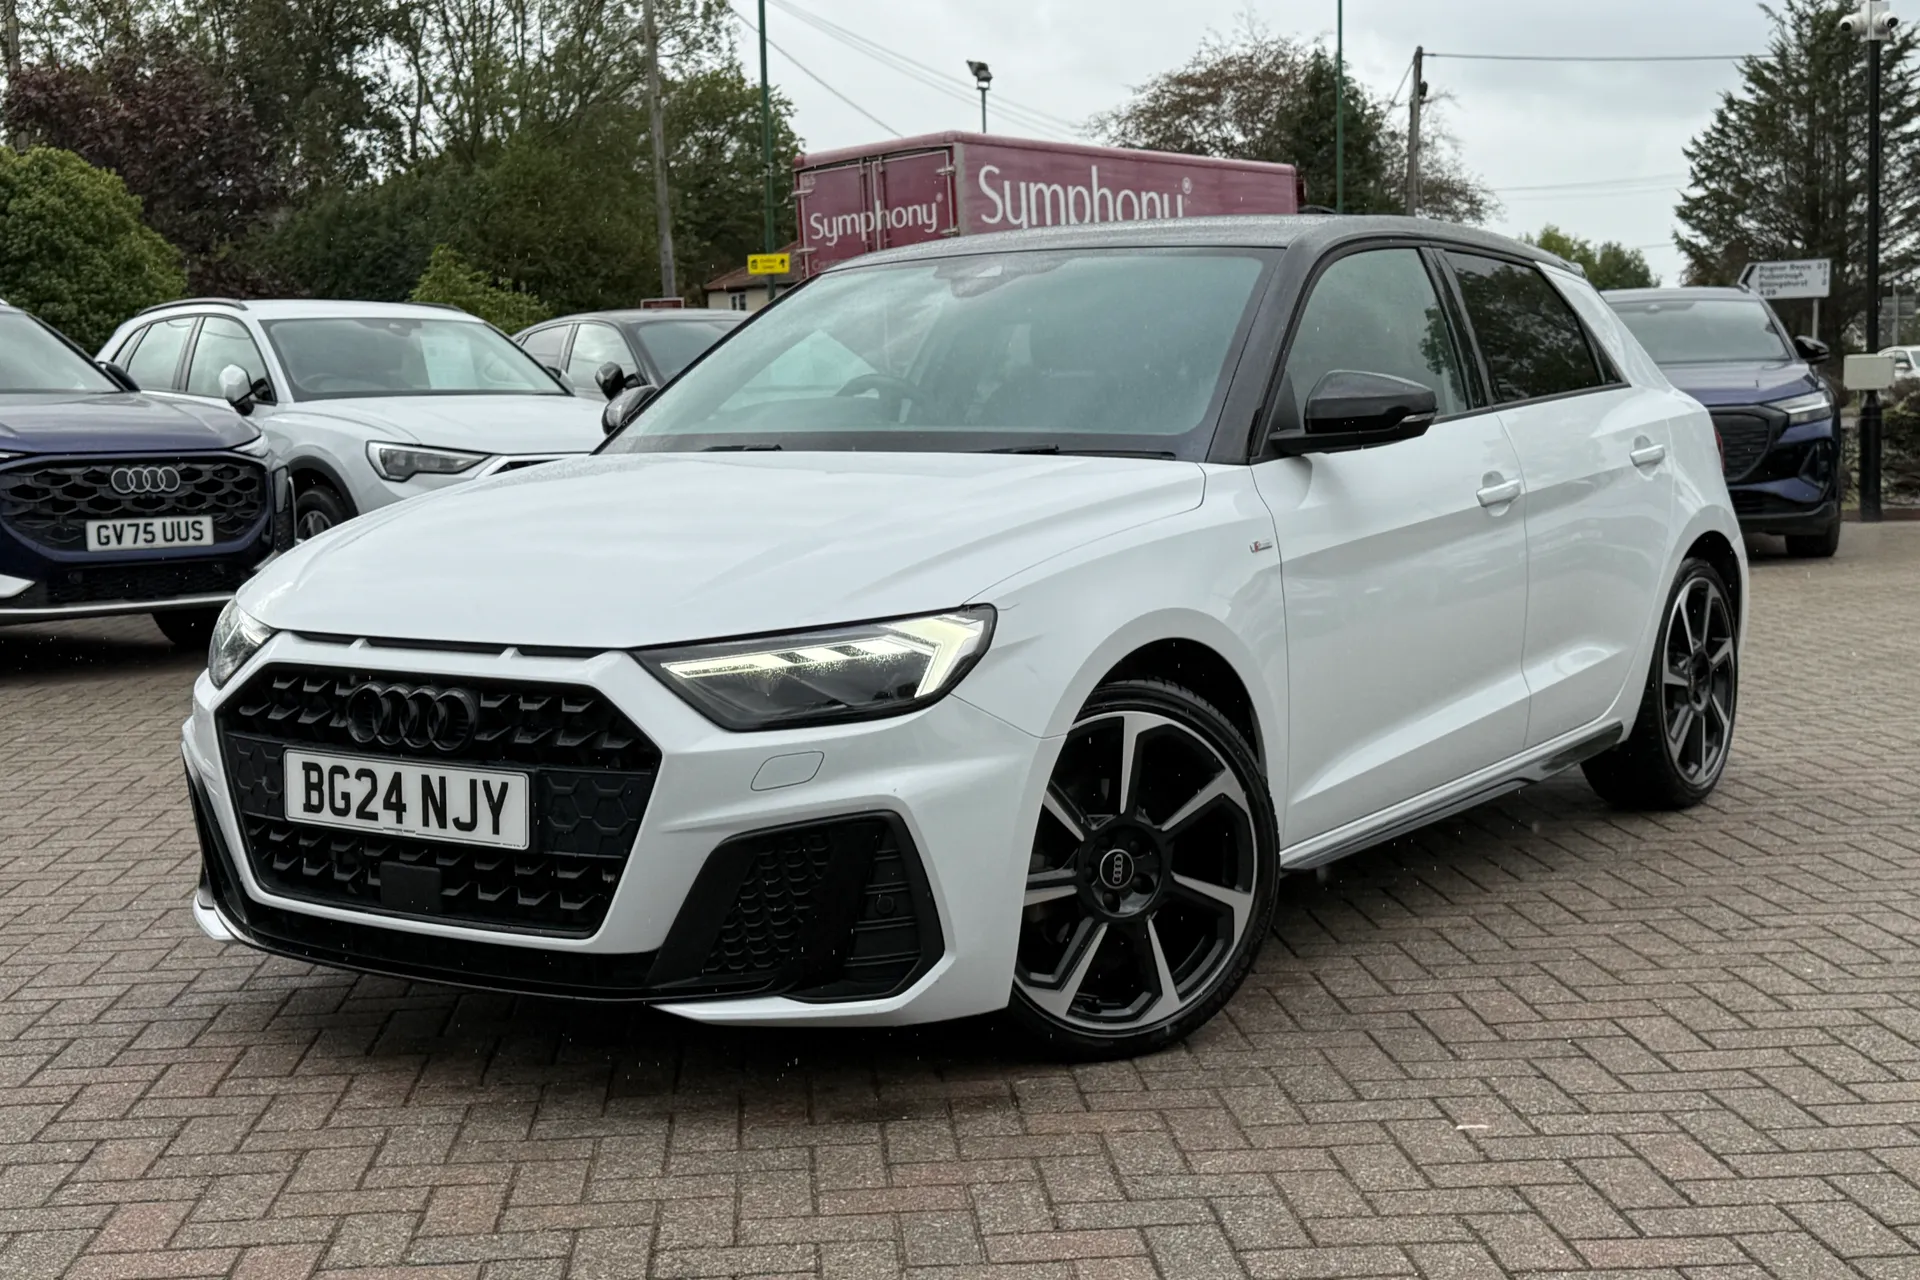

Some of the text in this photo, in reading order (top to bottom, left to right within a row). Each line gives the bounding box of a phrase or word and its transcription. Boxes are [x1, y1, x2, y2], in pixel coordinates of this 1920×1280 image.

[810, 199, 938, 247] Symphony
[97, 520, 204, 546] GV75 UUS
[302, 762, 509, 836] BG24 NJY
